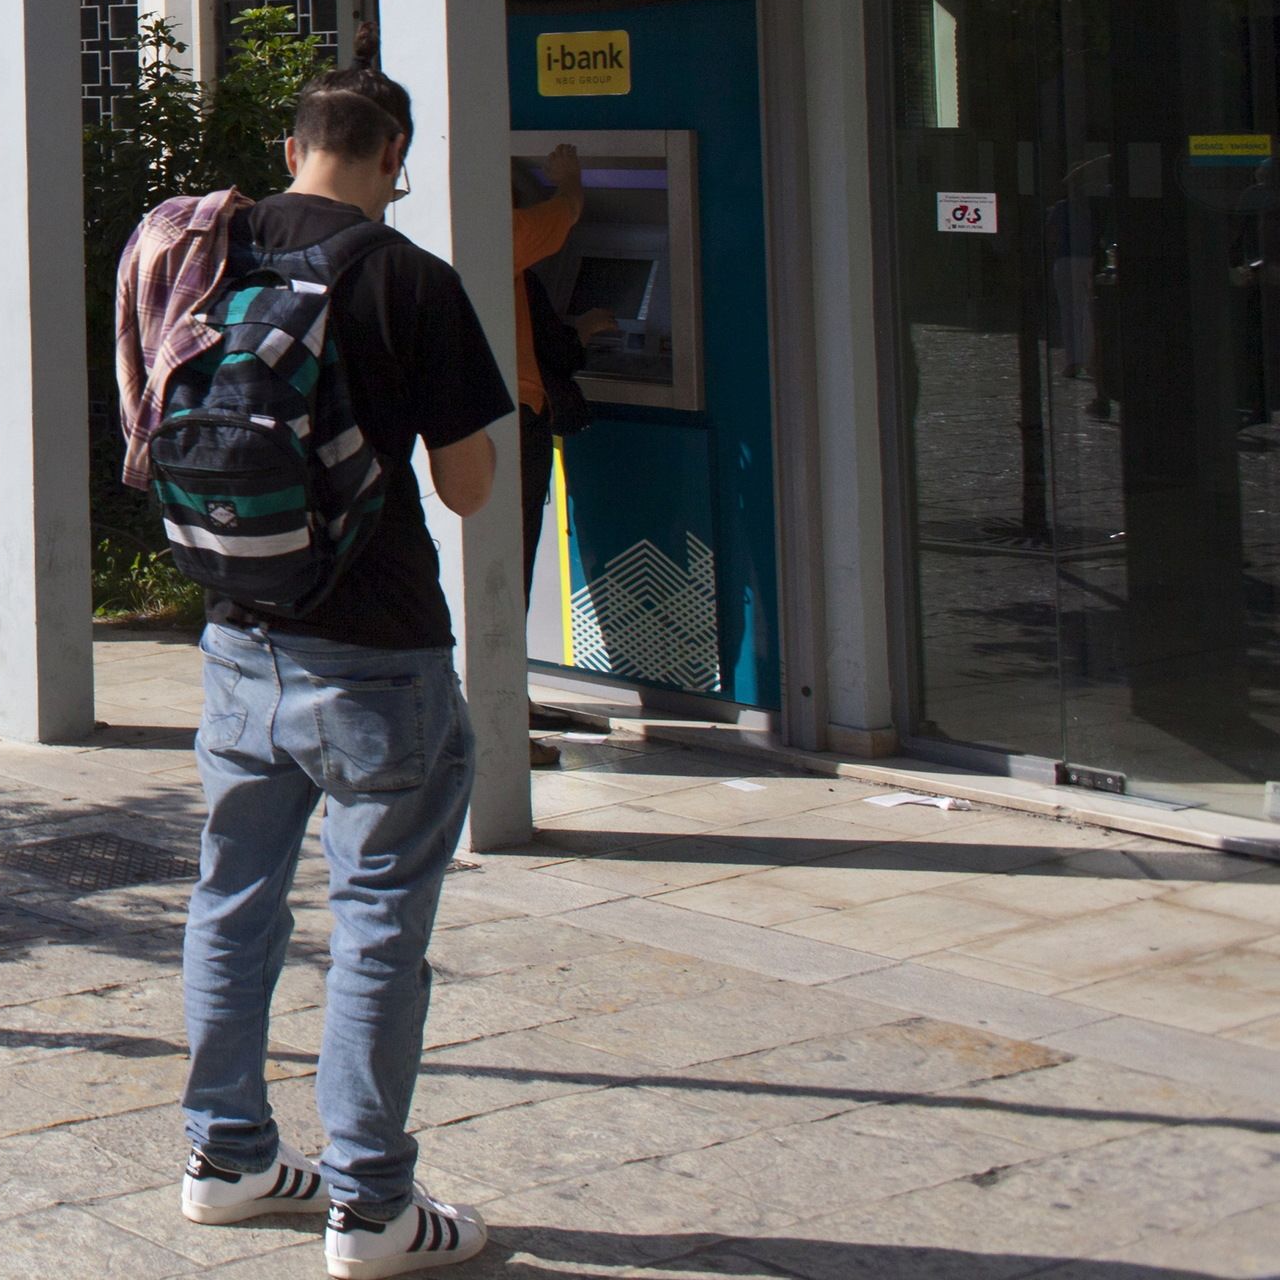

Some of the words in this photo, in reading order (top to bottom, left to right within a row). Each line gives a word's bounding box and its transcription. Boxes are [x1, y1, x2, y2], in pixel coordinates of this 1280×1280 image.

[546, 42, 624, 72] i-bank
[578, 75, 612, 85] GROUP
[951, 205, 982, 224] G4S
